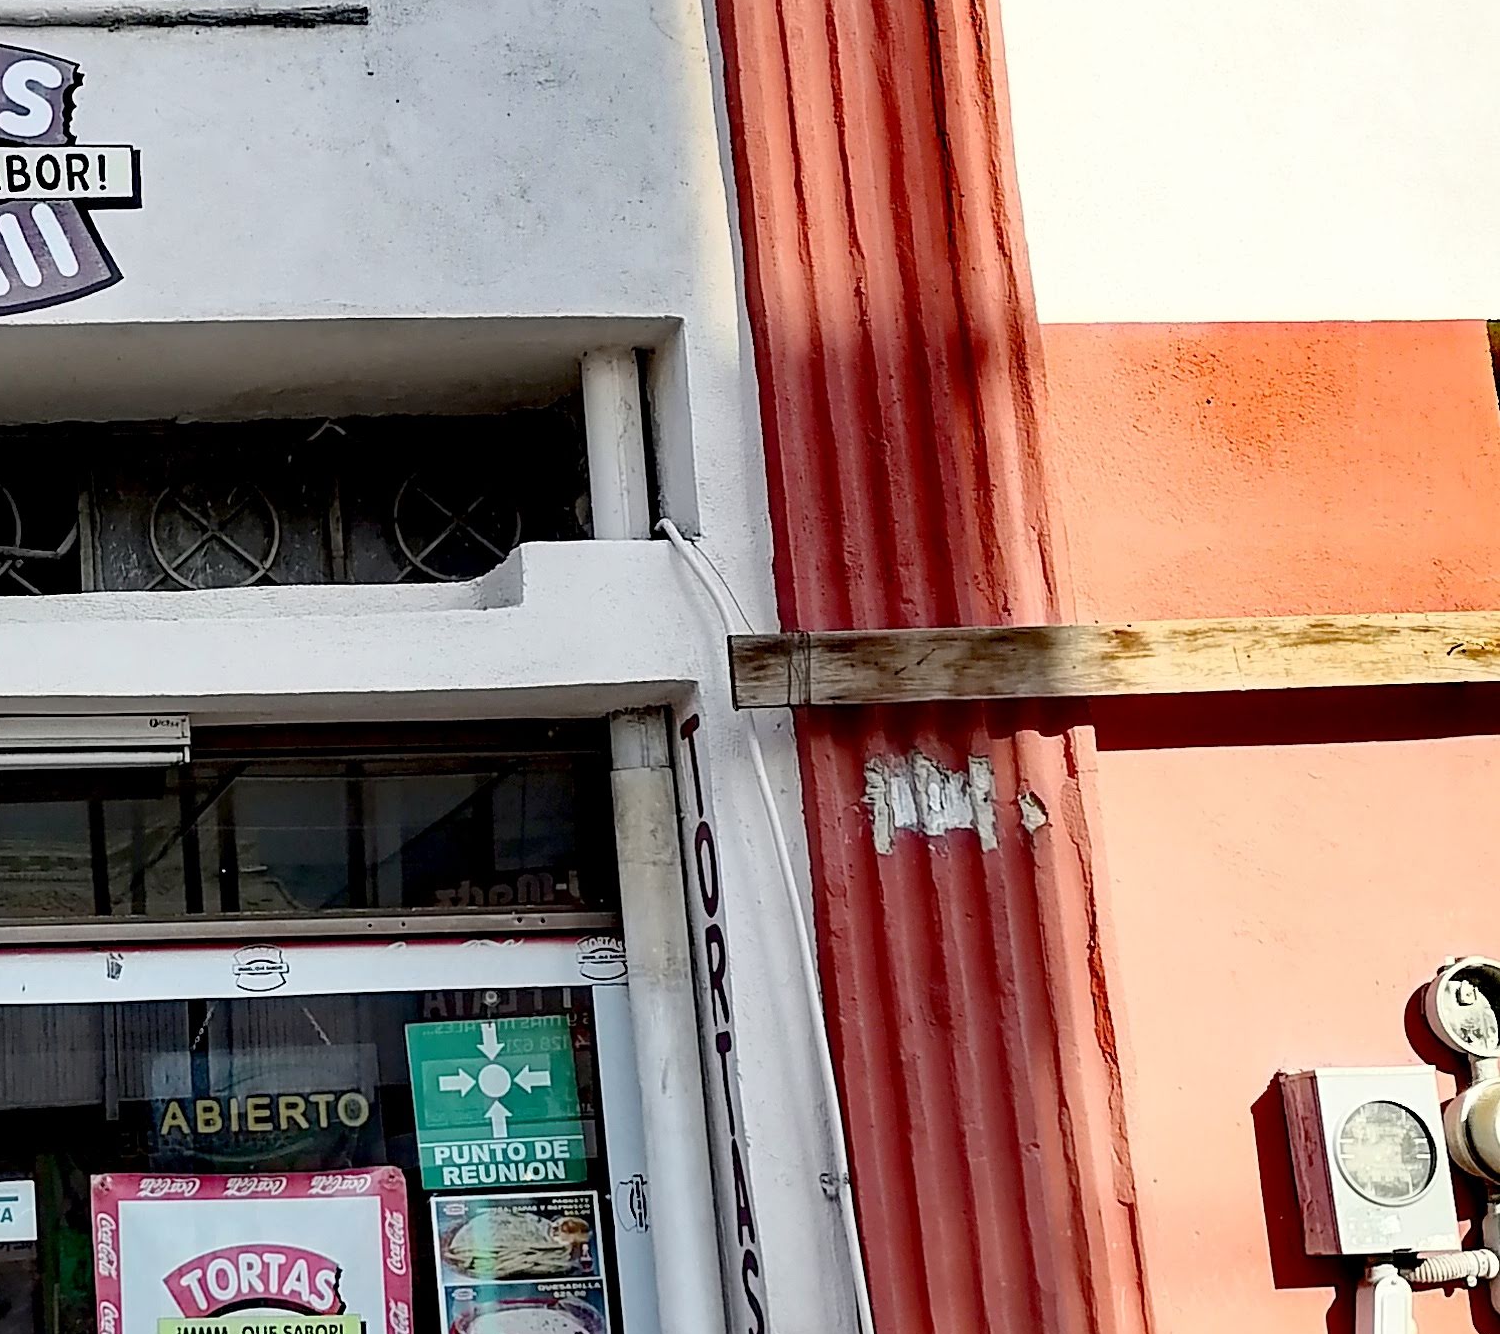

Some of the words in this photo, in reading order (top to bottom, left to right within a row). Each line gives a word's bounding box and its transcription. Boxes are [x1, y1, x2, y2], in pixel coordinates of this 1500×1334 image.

[160, 1092, 370, 1136] ABIERTO
[434, 1143, 526, 1166] PUNTO
[534, 1140, 570, 1160] DE
[442, 1162, 566, 1186] REUNION
[180, 1253, 336, 1312] TORTAS
[537, 1281, 601, 1291] QUESADILLA
